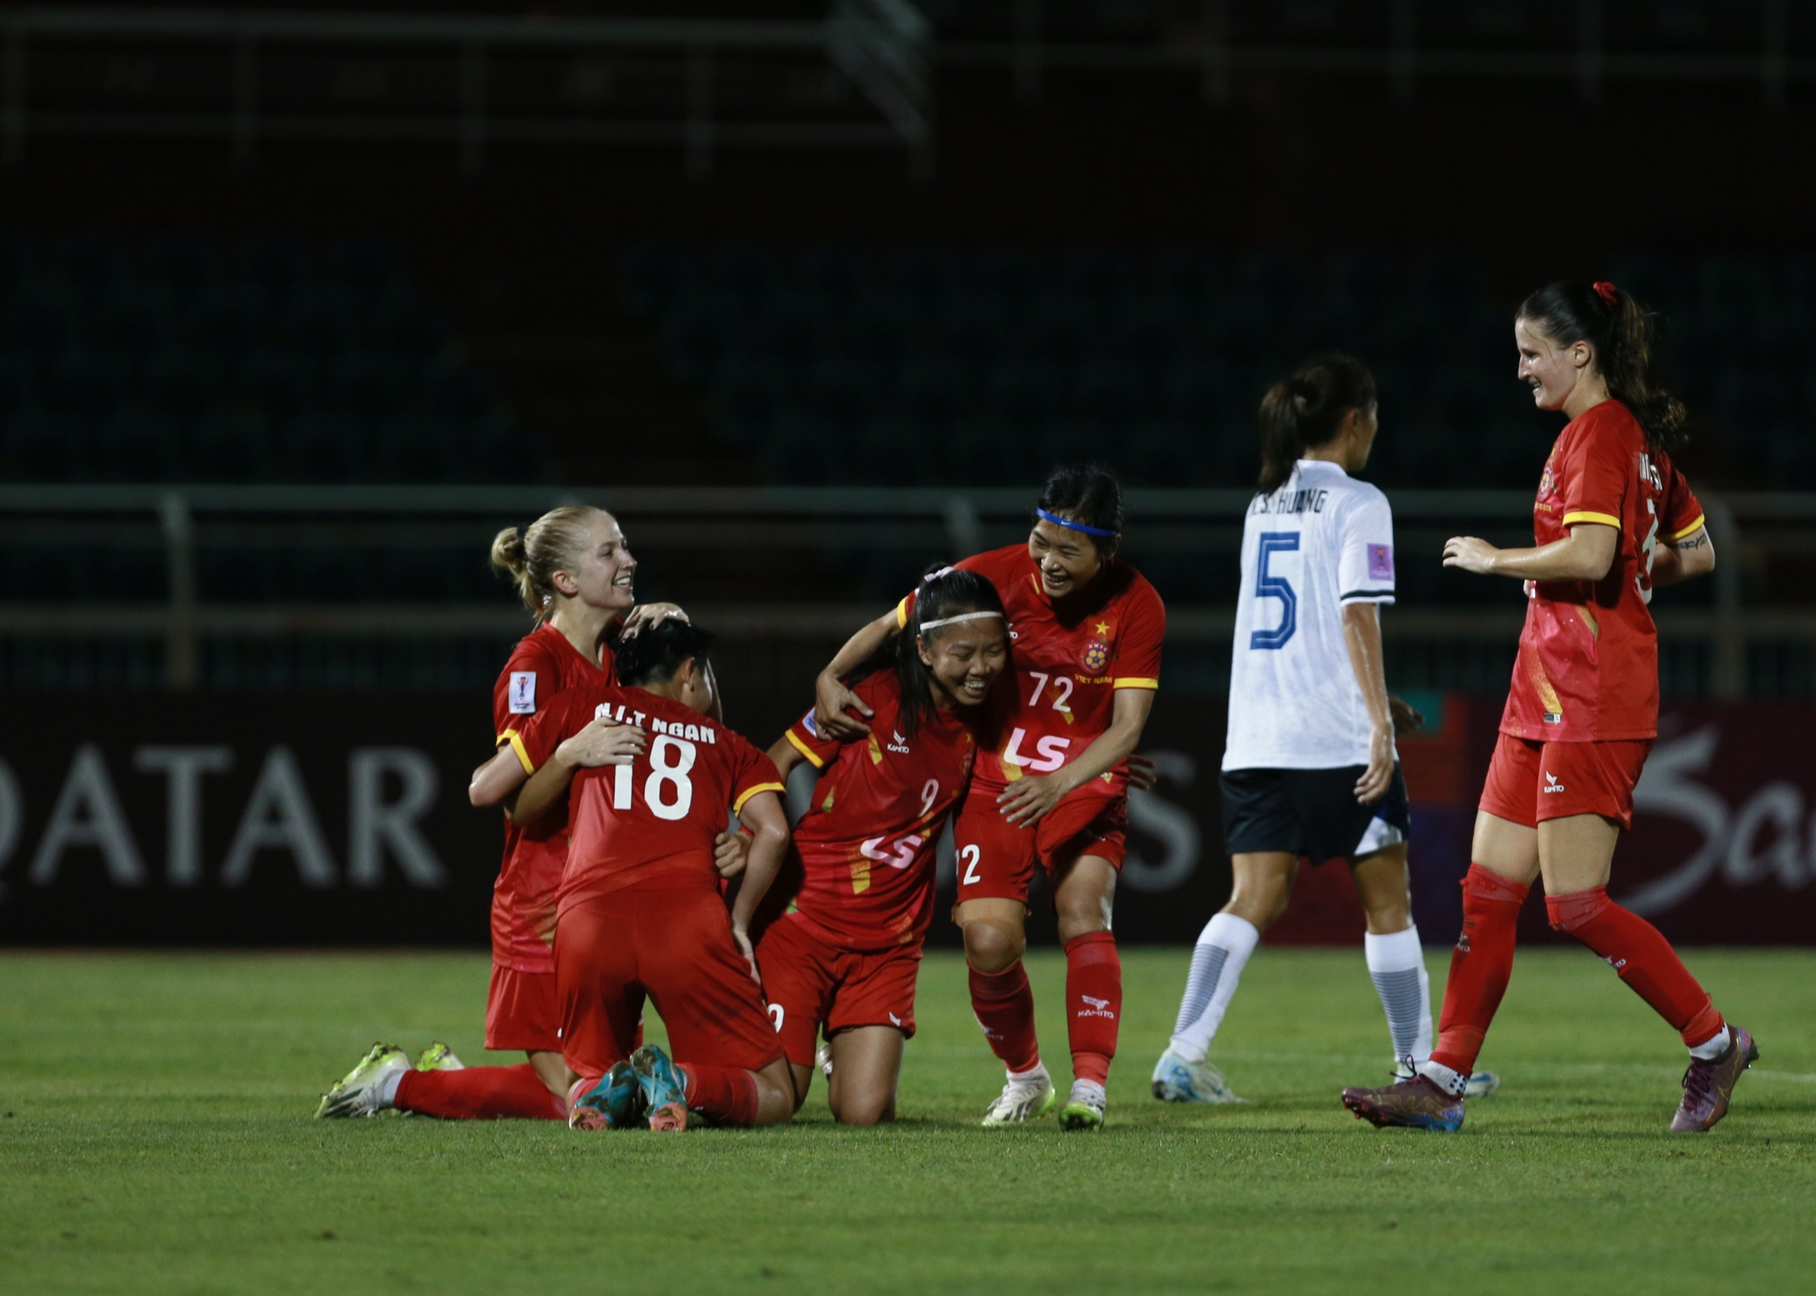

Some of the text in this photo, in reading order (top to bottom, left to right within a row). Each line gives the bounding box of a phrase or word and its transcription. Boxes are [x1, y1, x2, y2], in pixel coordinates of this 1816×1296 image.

[1277, 488, 1328, 514] HUANG
[1250, 531, 1300, 650] 5
[1028, 671, 1074, 713] 72
[651, 717, 716, 745] NGAN
[1003, 727, 1071, 772] LS
[613, 734, 697, 821] 18
[918, 778, 939, 817] 9
[0, 743, 453, 892] ATAR
[1613, 721, 1816, 918] Sa
[860, 834, 922, 869] LS
[1077, 1009, 1114, 1019] KAMITO
